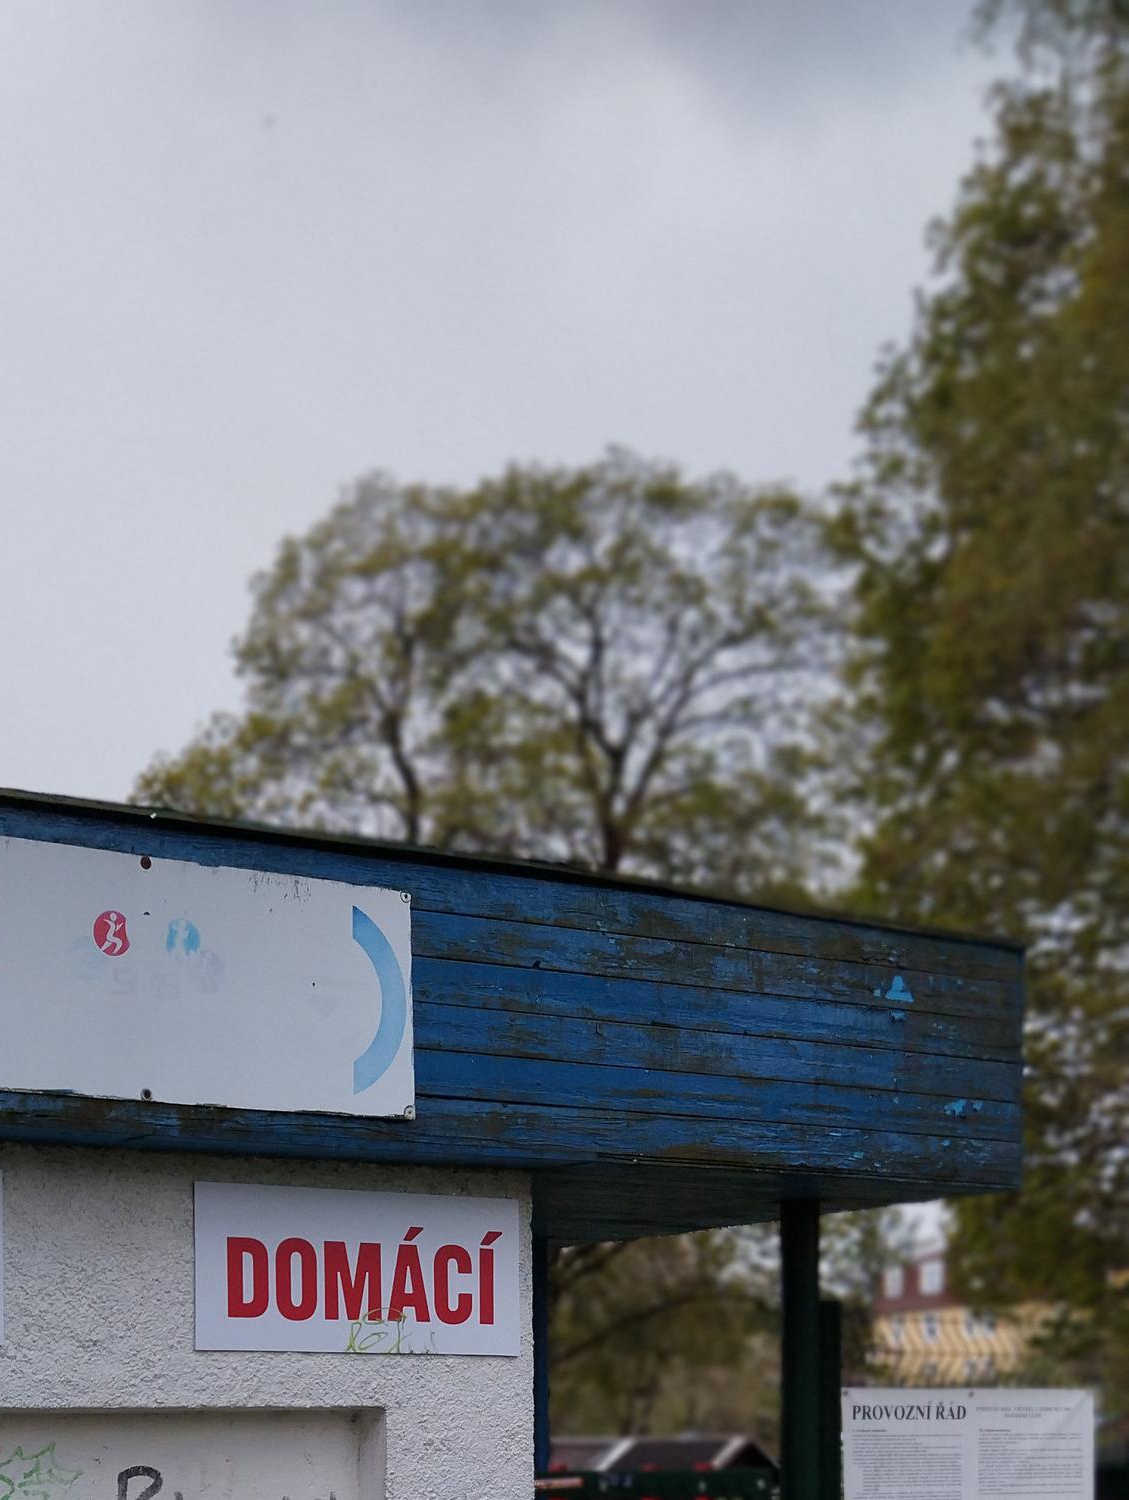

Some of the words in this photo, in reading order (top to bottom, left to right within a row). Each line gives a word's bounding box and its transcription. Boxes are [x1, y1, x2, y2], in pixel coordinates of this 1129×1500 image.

[226, 1226, 503, 1326] DOMÁCÍ
[851, 1400, 931, 1421] PROVOZNÍ
[935, 1400, 967, 1421] ŘÁD
